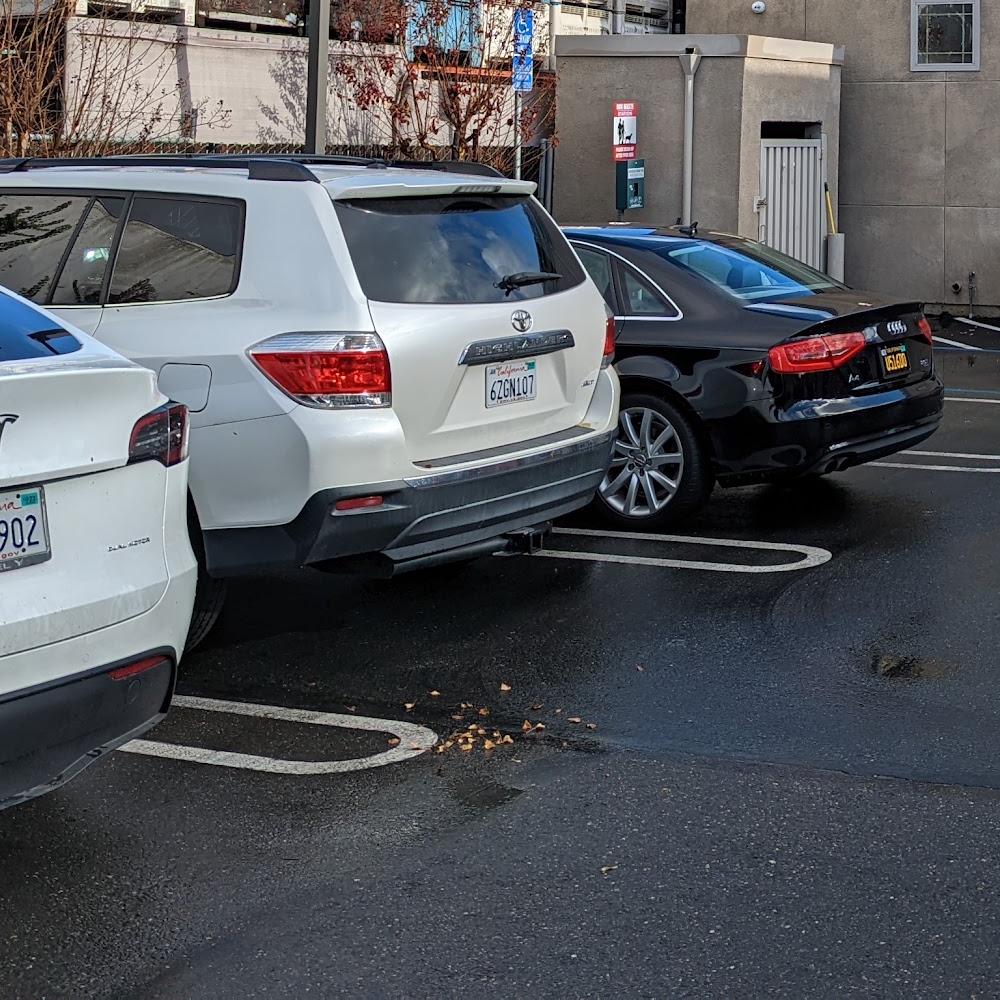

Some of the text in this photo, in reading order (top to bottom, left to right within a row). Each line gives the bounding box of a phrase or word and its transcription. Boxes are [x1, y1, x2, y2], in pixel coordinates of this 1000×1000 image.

[475, 334, 569, 356] HIGHLANDER
[495, 364, 528, 378] California
[490, 374, 535, 401] 6ZGN107
[0, 514, 39, 551] 902
